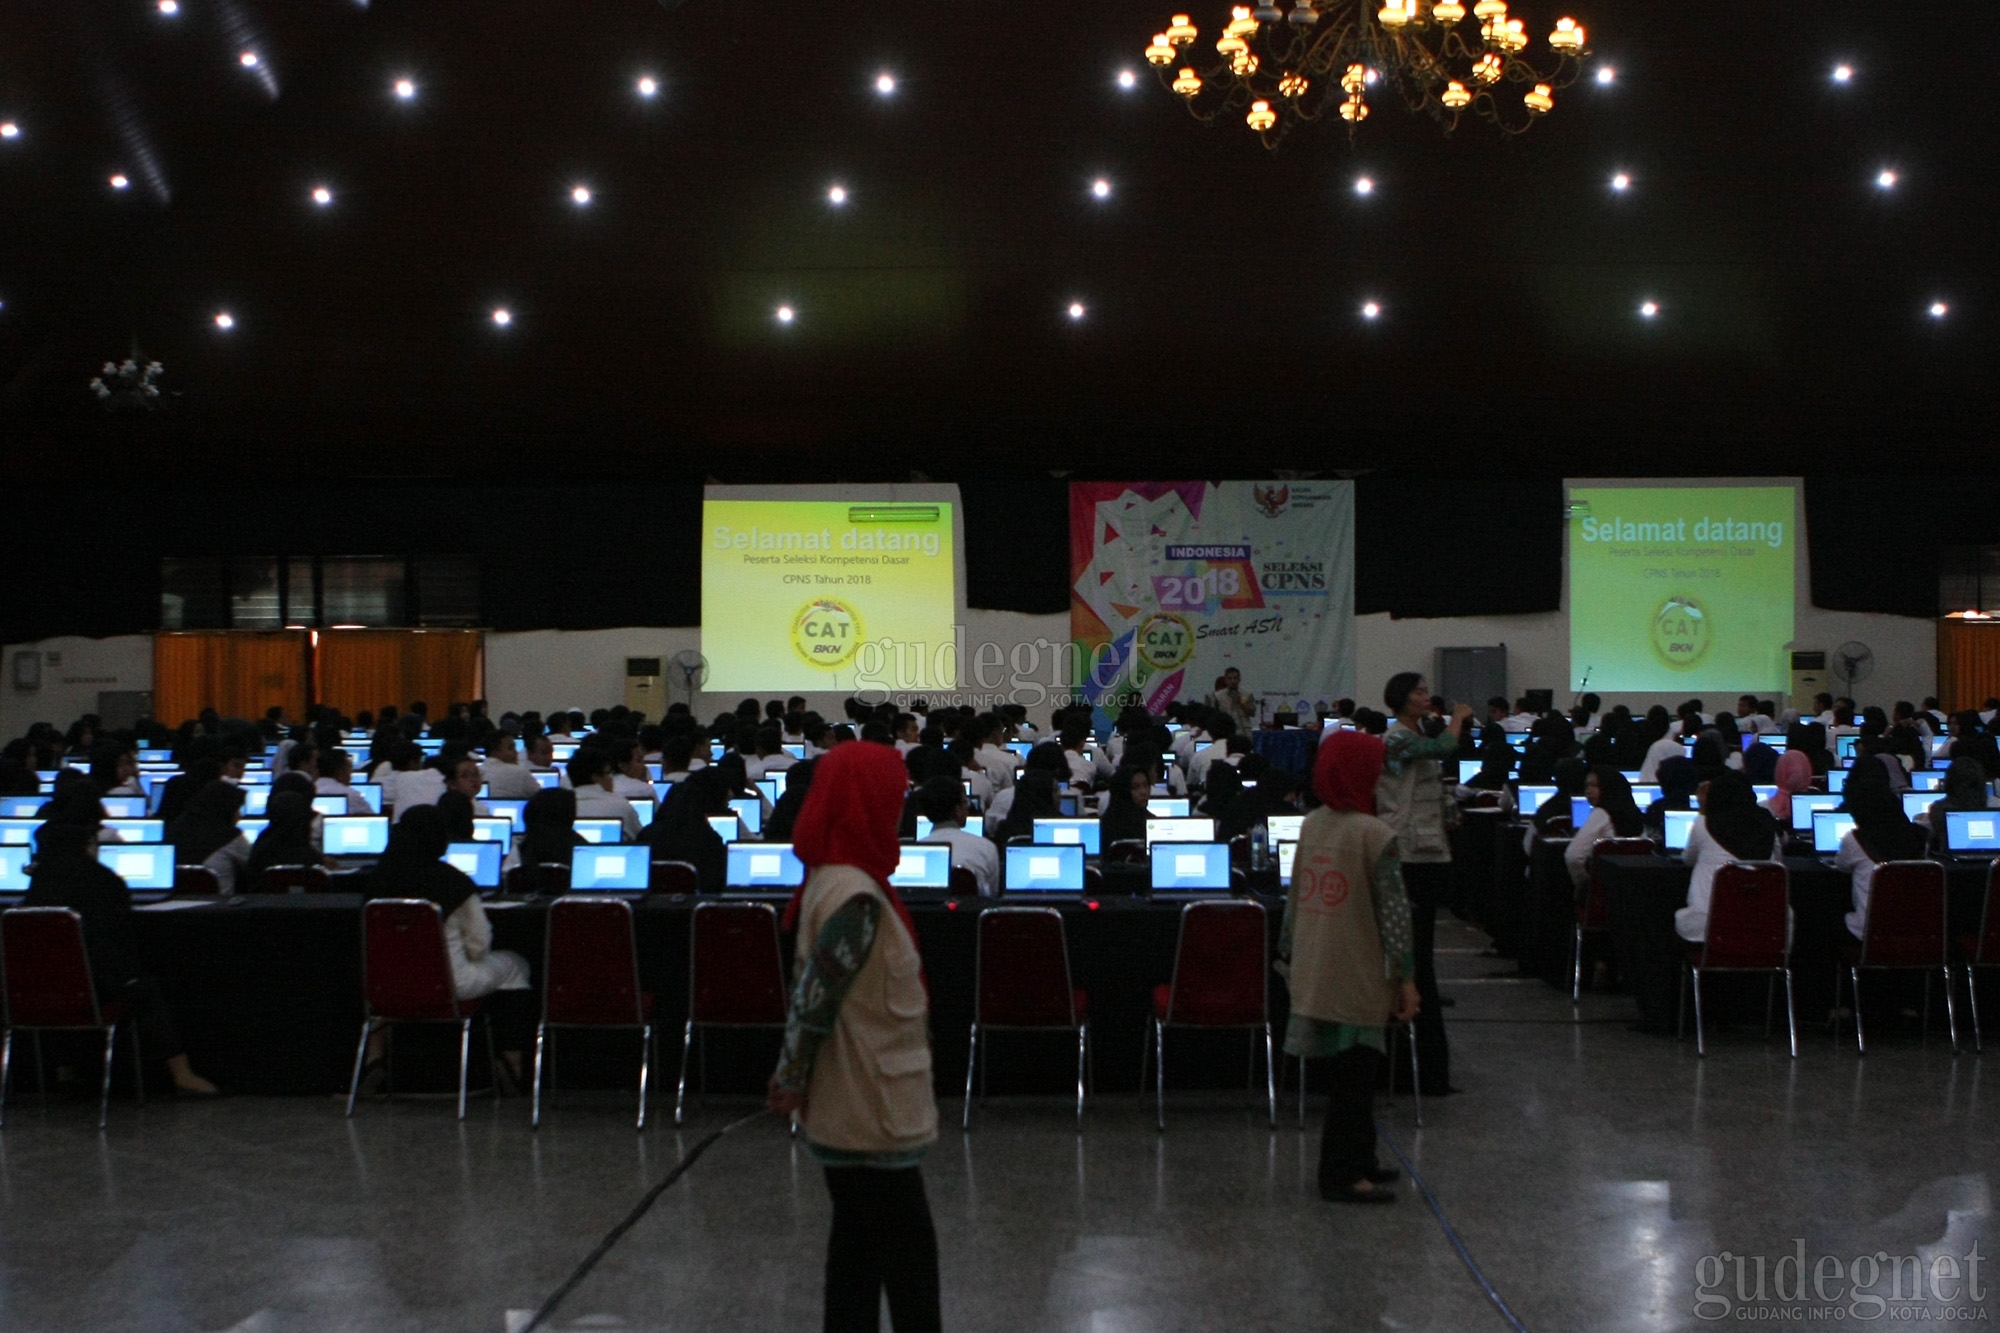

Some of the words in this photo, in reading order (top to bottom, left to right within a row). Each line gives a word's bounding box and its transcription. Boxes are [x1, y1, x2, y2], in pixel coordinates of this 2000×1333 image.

[1581, 516, 1686, 542] Selamat
[1693, 516, 1784, 548] datang
[712, 526, 832, 550] Selamat
[840, 527, 940, 557] datang
[743, 554, 780, 565] Peserta
[783, 554, 817, 565] Seleksi
[820, 554, 879, 566] Kompetensi
[882, 554, 910, 565] Dasar
[1171, 547, 1246, 558] INDONESIA
[1262, 562, 1323, 573] SELEKSI
[783, 574, 811, 585] CPNS
[814, 574, 844, 585] Tahun
[847, 574, 871, 585] 2018
[1160, 567, 1240, 605] 2018
[1261, 573, 1325, 590] CPNS
[804, 621, 850, 638] CAT
[1196, 624, 1240, 640] Smart
[1243, 617, 1284, 635] ASN
[1661, 619, 1701, 636] CAT
[1147, 631, 1184, 646] CAT
[813, 644, 842, 654] BKN
[1153, 650, 1178, 659] BKN
[1669, 643, 1694, 652] BKN
